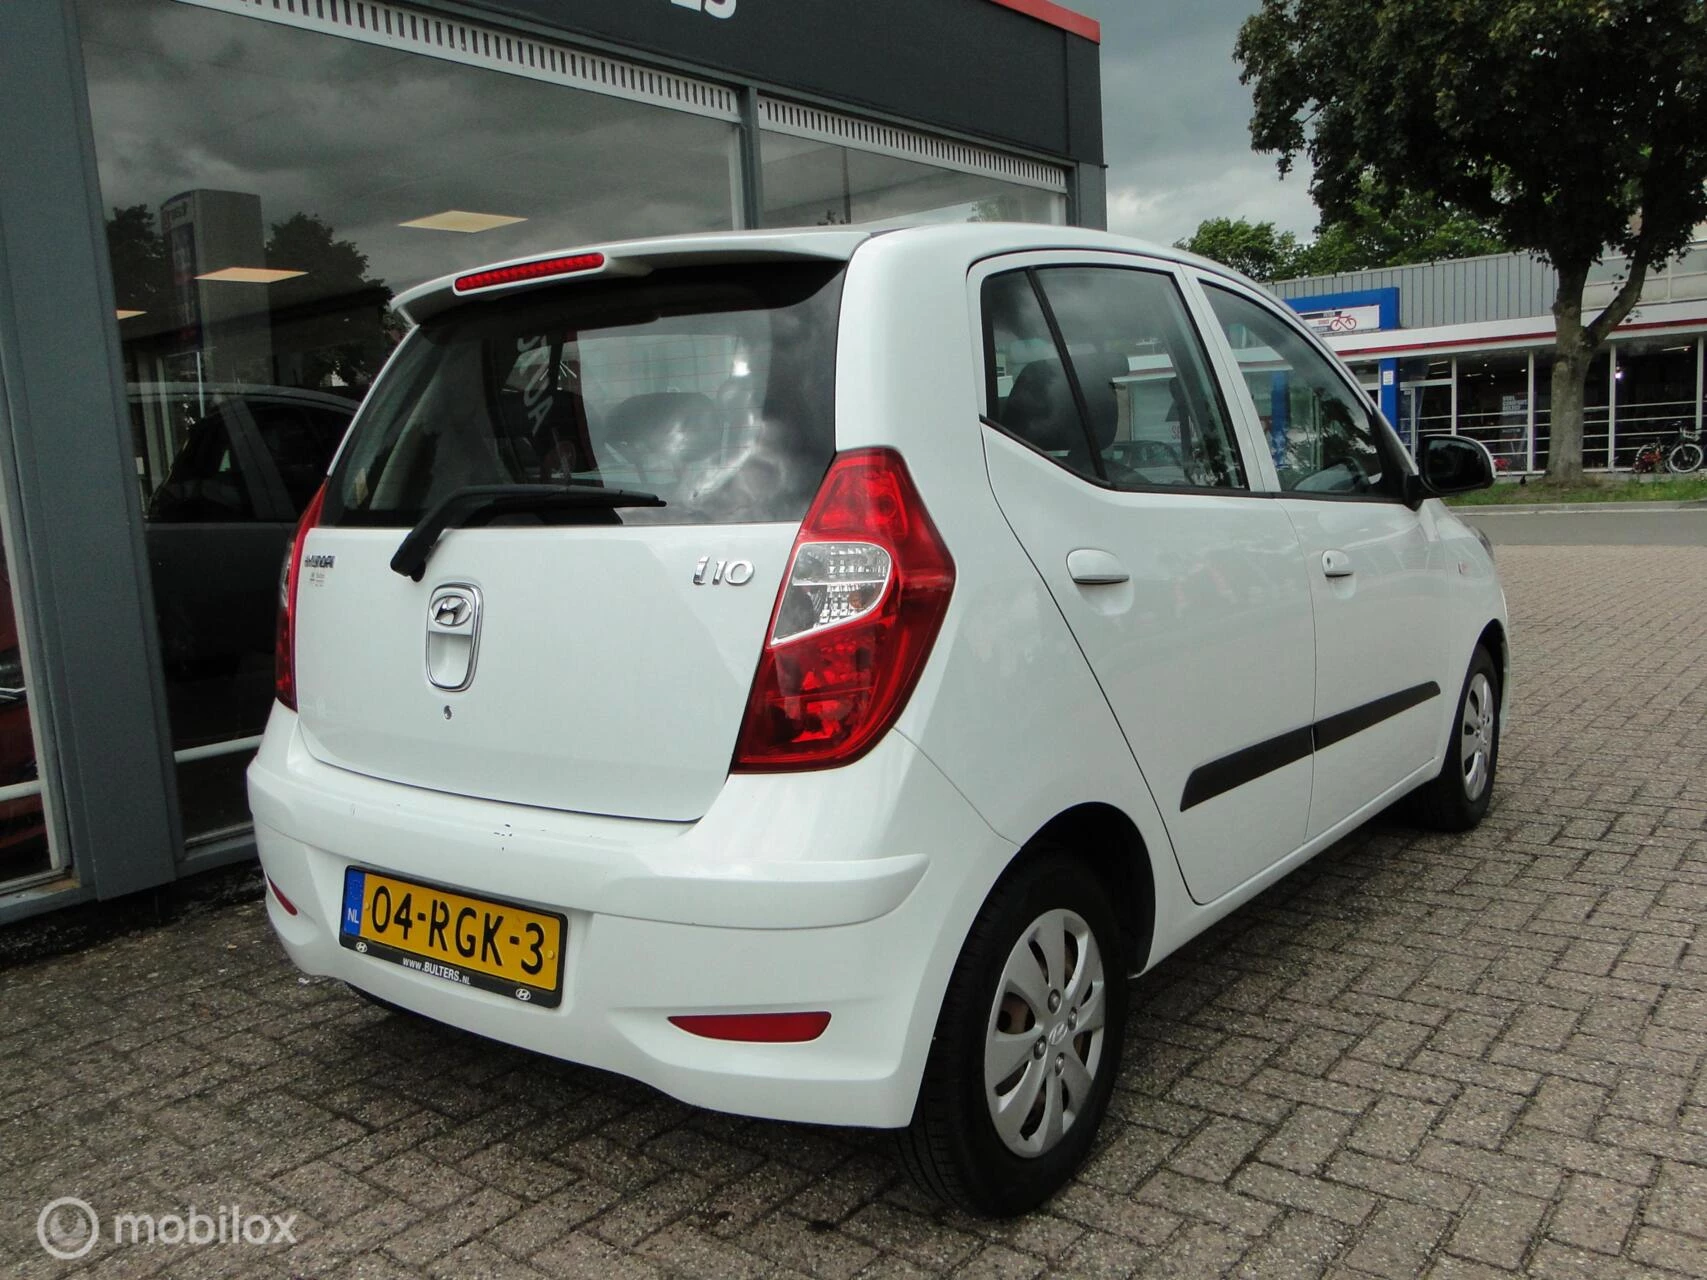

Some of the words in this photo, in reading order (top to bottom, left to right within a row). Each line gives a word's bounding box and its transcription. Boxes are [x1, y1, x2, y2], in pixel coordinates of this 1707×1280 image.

[693, 556, 755, 586] i10
[347, 907, 360, 924] NL
[372, 886, 545, 975] 04-RGK-3
